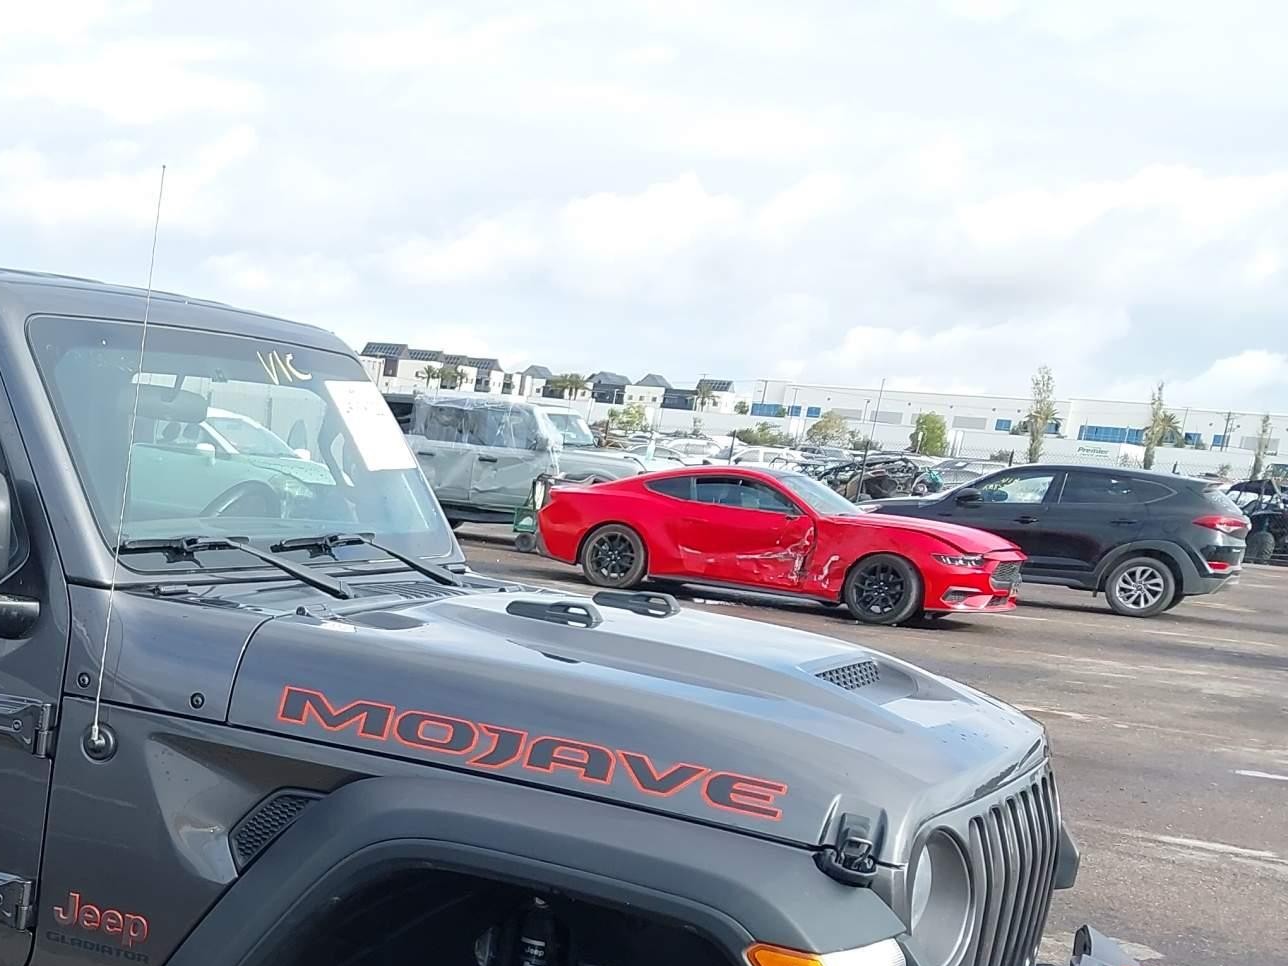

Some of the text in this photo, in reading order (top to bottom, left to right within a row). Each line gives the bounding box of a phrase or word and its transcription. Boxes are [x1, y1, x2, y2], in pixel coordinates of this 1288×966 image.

[276, 685, 789, 821] MOJAVE
[45, 930, 151, 964] GLADIATOR
[52, 889, 149, 949] Jeep
